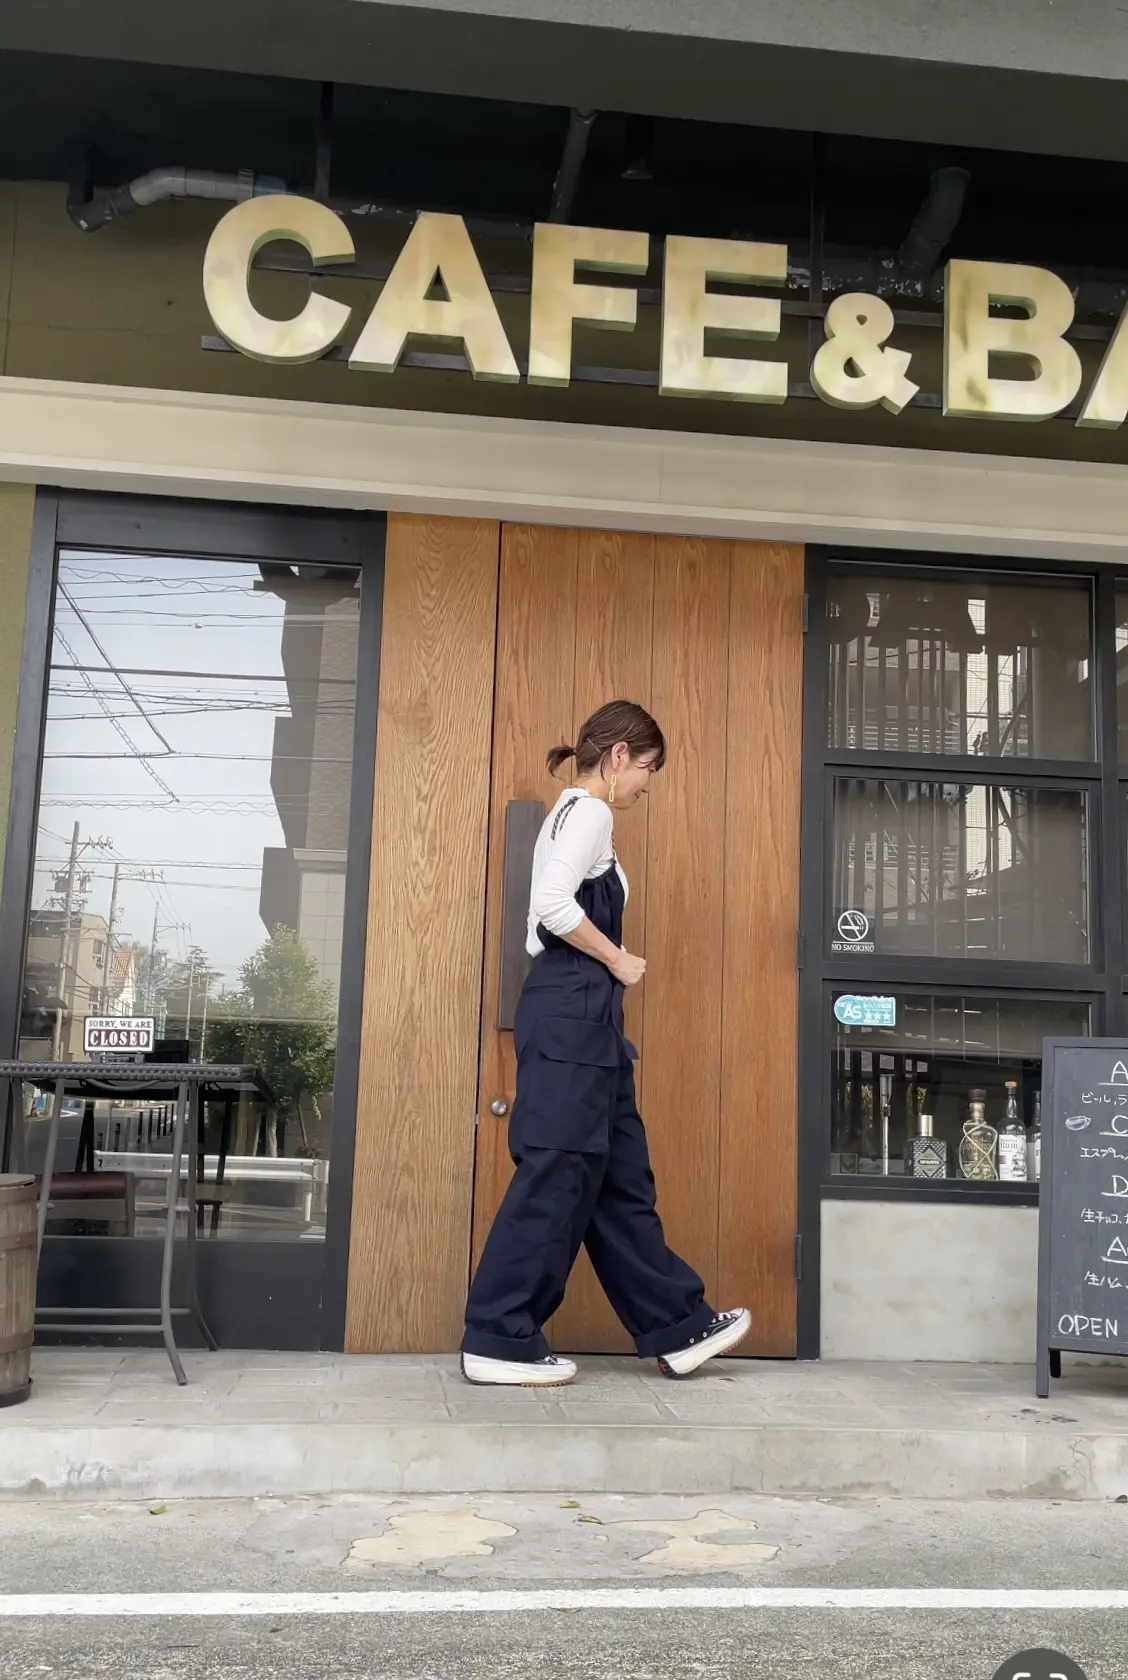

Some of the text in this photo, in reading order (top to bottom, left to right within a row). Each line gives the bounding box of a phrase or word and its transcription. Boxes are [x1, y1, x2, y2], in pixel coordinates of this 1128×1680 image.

[831, 943, 875, 953] NO SMOKING
[120, 1020, 133, 1028] WE
[134, 1021, 152, 1029] ARE
[90, 1031, 148, 1046] CLOSED
[1058, 1314, 1118, 1338] OPEN
